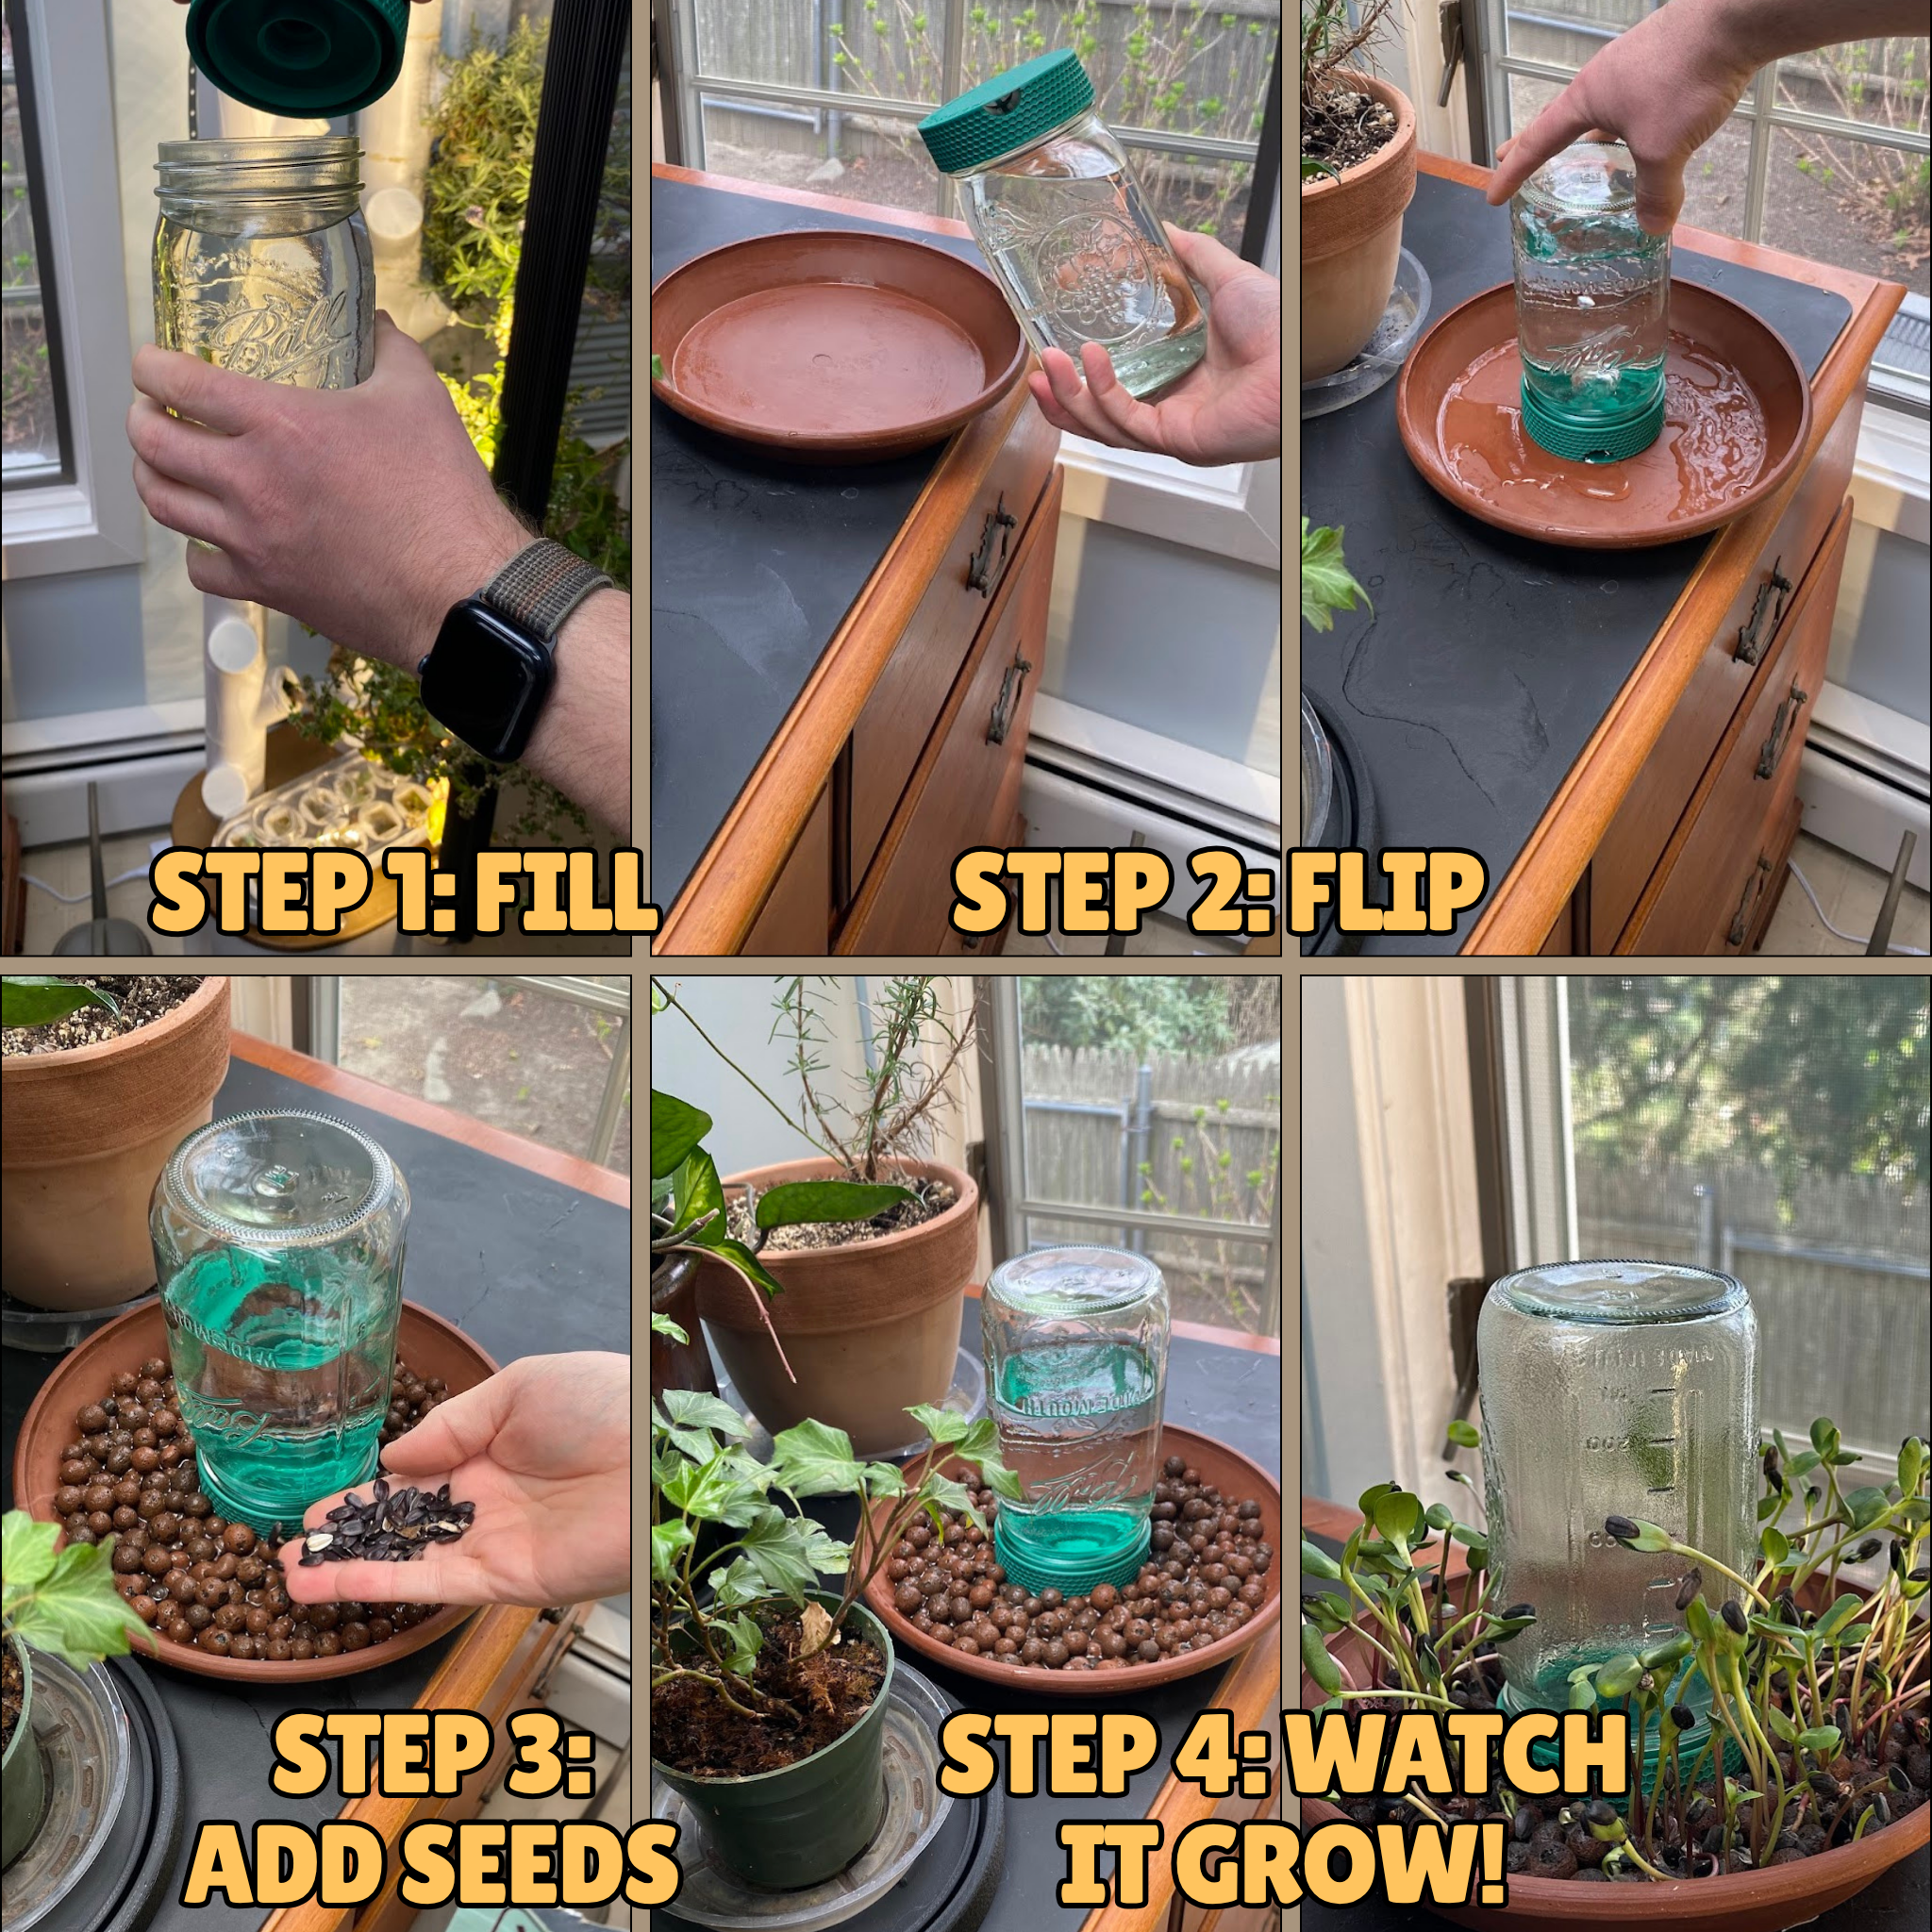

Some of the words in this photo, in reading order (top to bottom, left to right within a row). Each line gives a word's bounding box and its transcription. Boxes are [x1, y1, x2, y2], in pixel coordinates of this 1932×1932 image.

[208, 291, 354, 381] Ball
[1022, 1396, 1092, 1417] MOUTH
[1587, 1436, 1630, 1453] 200
[1030, 1450, 1138, 1517] Ball
